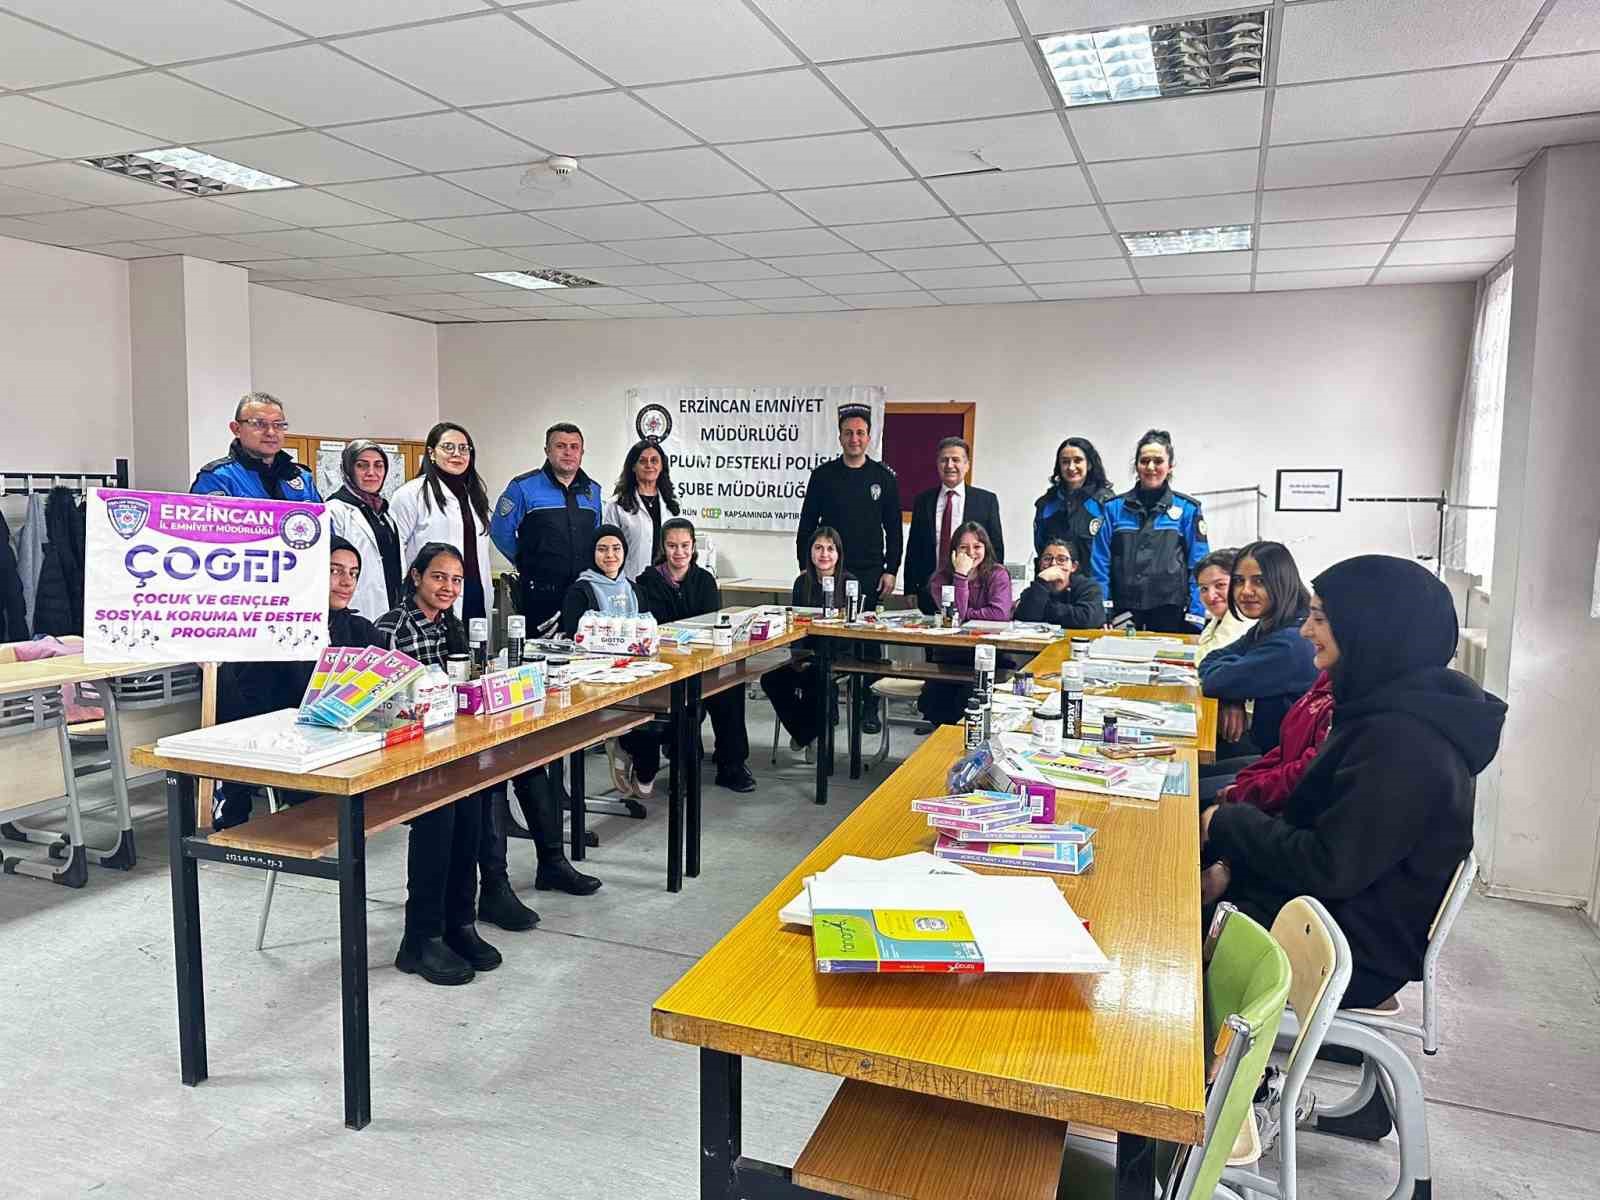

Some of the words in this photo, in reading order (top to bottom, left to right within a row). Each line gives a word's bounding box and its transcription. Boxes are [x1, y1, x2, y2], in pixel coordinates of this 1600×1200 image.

[680, 397, 751, 413] ERZİNCAN
[755, 397, 824, 413] EMNİYET
[701, 425, 799, 442] MÜDÜRLÜĞÜ
[669, 454, 711, 469] PLUM
[715, 453, 781, 471] DESTEKLİ
[677, 482, 713, 498] ŞUBE
[717, 480, 806, 499] MÜDÜRLÜĞ
[160, 502, 274, 526] ERZİNCAN
[724, 510, 774, 520] KAPSAMINDA
[160, 519, 169, 530] İL
[170, 521, 214, 533] EMNİYET
[215, 523, 275, 536] MÜDÜRLÜĞÜ
[124, 544, 298, 589] ÇOGEP
[133, 592, 191, 607] ÇOCUK
[197, 593, 217, 606] VE
[219, 595, 290, 609] GENÇLER
[95, 609, 162, 622] SOSYAL
[166, 610, 239, 622] KORUMA
[243, 611, 262, 623] VE
[264, 611, 323, 623] DESTEK
[170, 627, 257, 639] PROGRAMI
[1067, 702, 1075, 735] SPRAY
